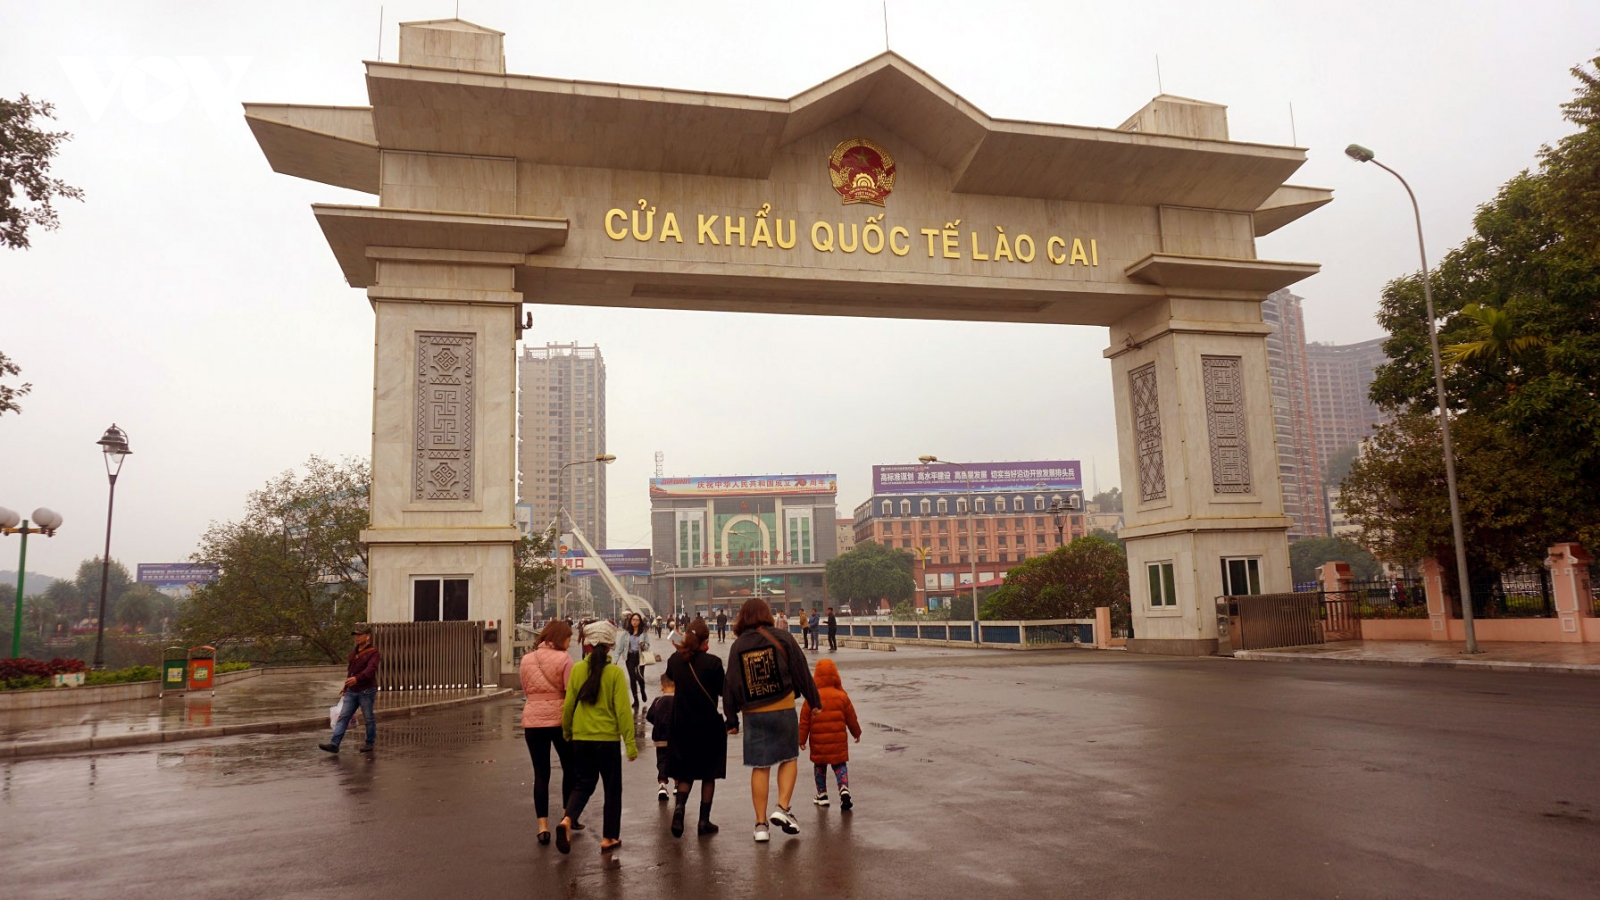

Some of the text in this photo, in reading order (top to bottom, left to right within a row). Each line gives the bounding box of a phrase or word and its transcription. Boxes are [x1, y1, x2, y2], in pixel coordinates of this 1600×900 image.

[604, 198, 1099, 266] CỬA KHẨU QUỐC TẾ LÀO CAI
